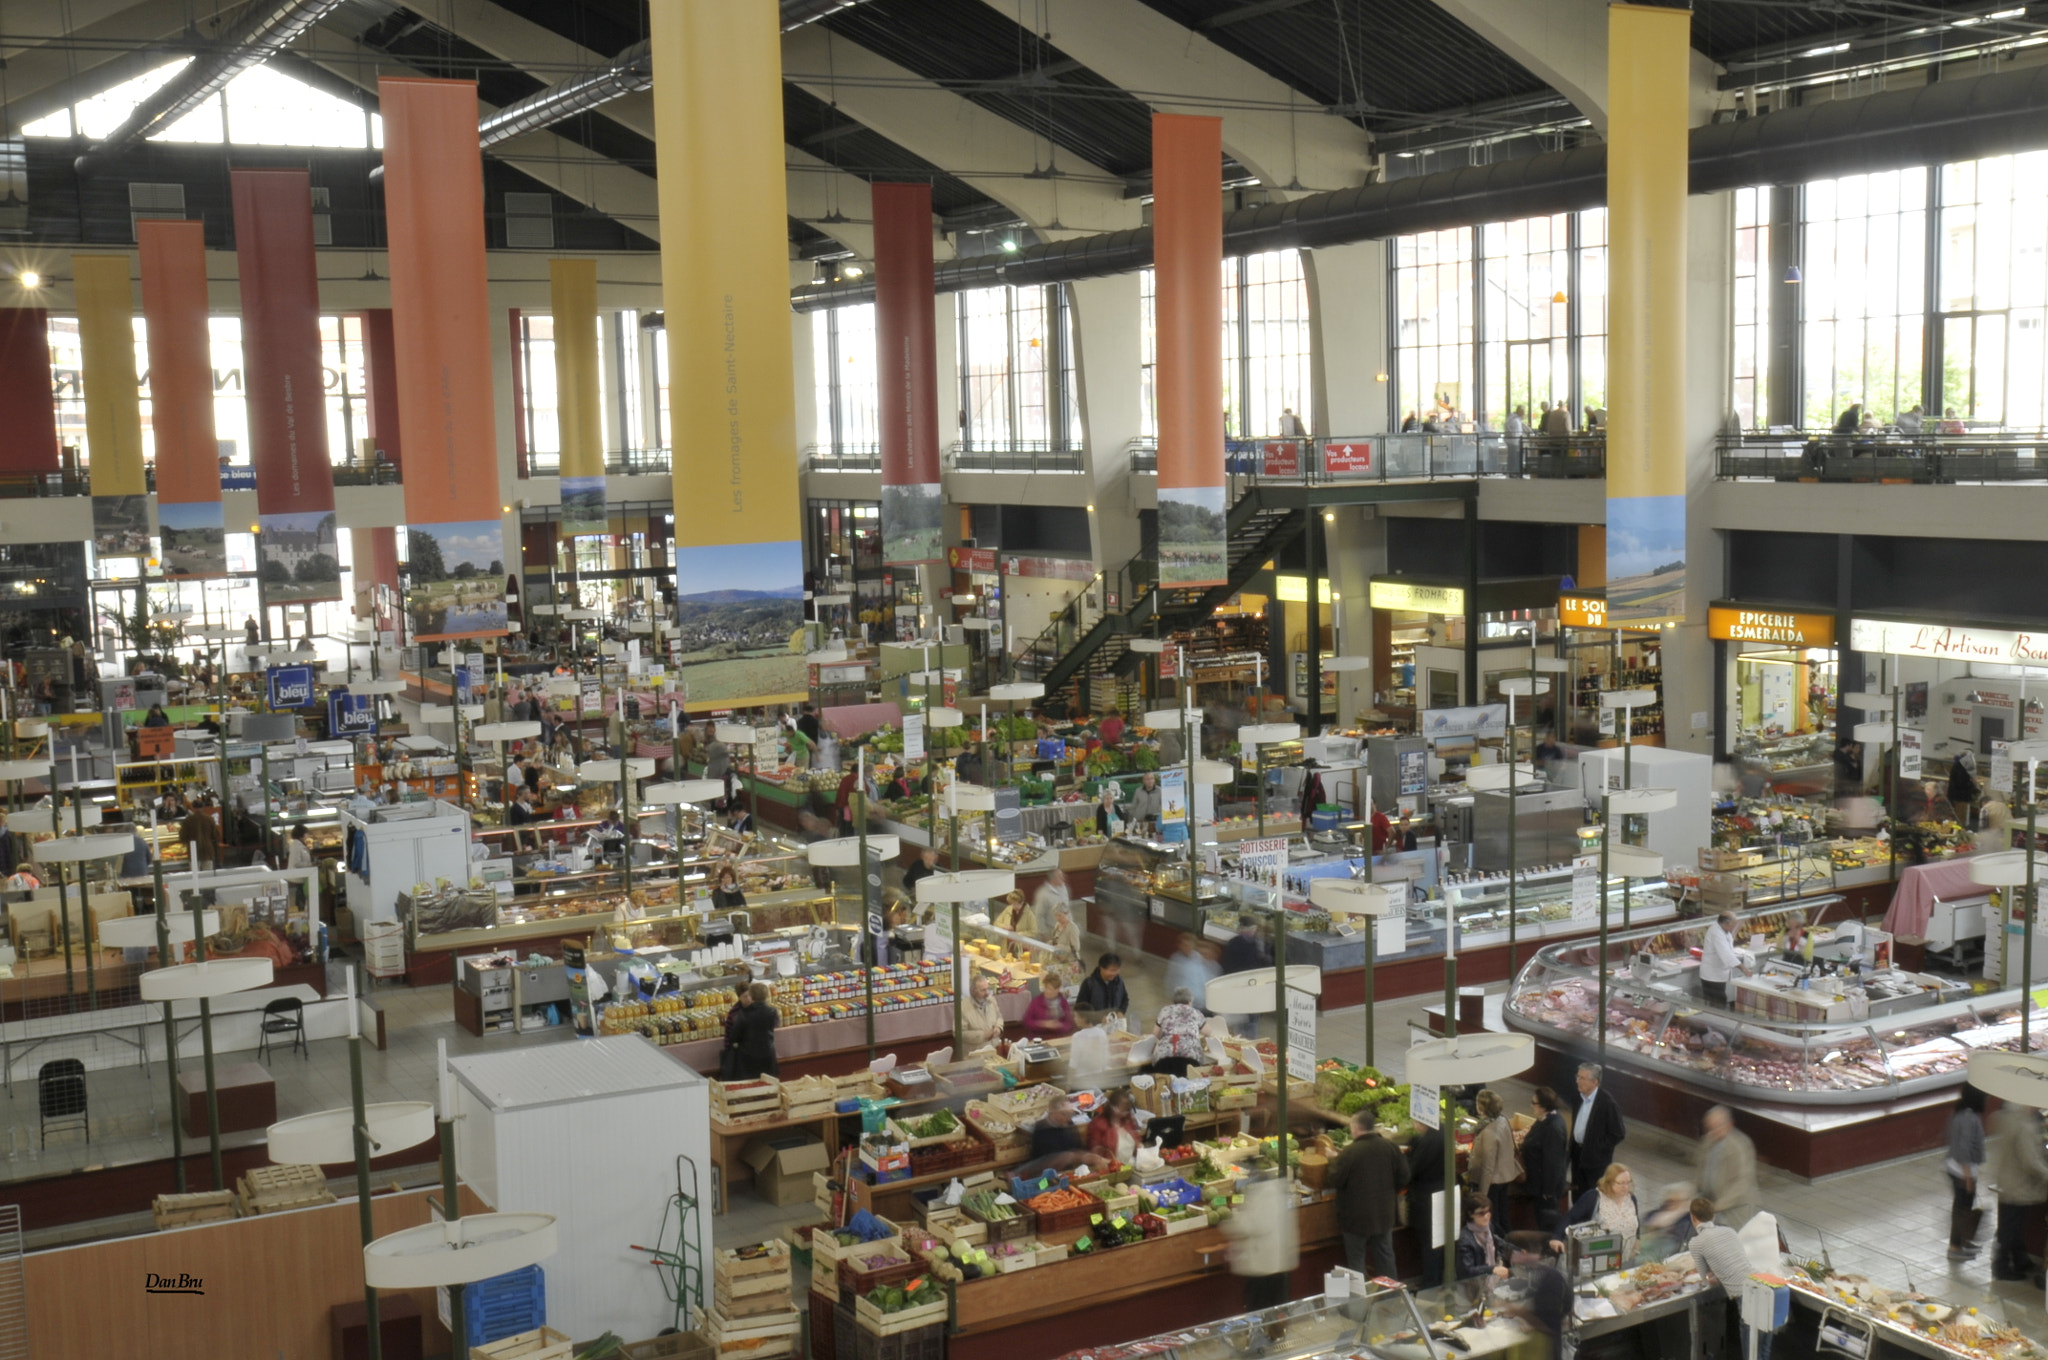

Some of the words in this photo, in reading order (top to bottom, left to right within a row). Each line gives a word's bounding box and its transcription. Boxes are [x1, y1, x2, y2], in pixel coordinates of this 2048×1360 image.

[724, 294, 737, 394] Saint-Nectaire
[286, 404, 294, 414] de
[728, 400, 739, 416] de
[287, 416, 295, 429] Val
[288, 430, 296, 440] du
[730, 420, 742, 485] fromages
[1326, 450, 1338, 458] Vos
[290, 443, 299, 480] domaines
[1330, 456, 1366, 464] producteurs
[232, 470, 252, 478] bleu
[733, 489, 743, 512] Les
[972, 551, 994, 560] PRESSE
[1415, 588, 1458, 602] FROMAGES
[1566, 599, 1577, 611] LE
[1588, 614, 1602, 626] DU
[1740, 612, 1795, 628] EPICERIE
[1730, 625, 1804, 642] ESMERALDA
[1910, 626, 1999, 656] L'Artisan
[280, 686, 308, 699] bleu
[344, 711, 374, 725] bleu
[1240, 838, 1286, 854] ROTISSERIE
[1242, 854, 1280, 867] COUSCOU
